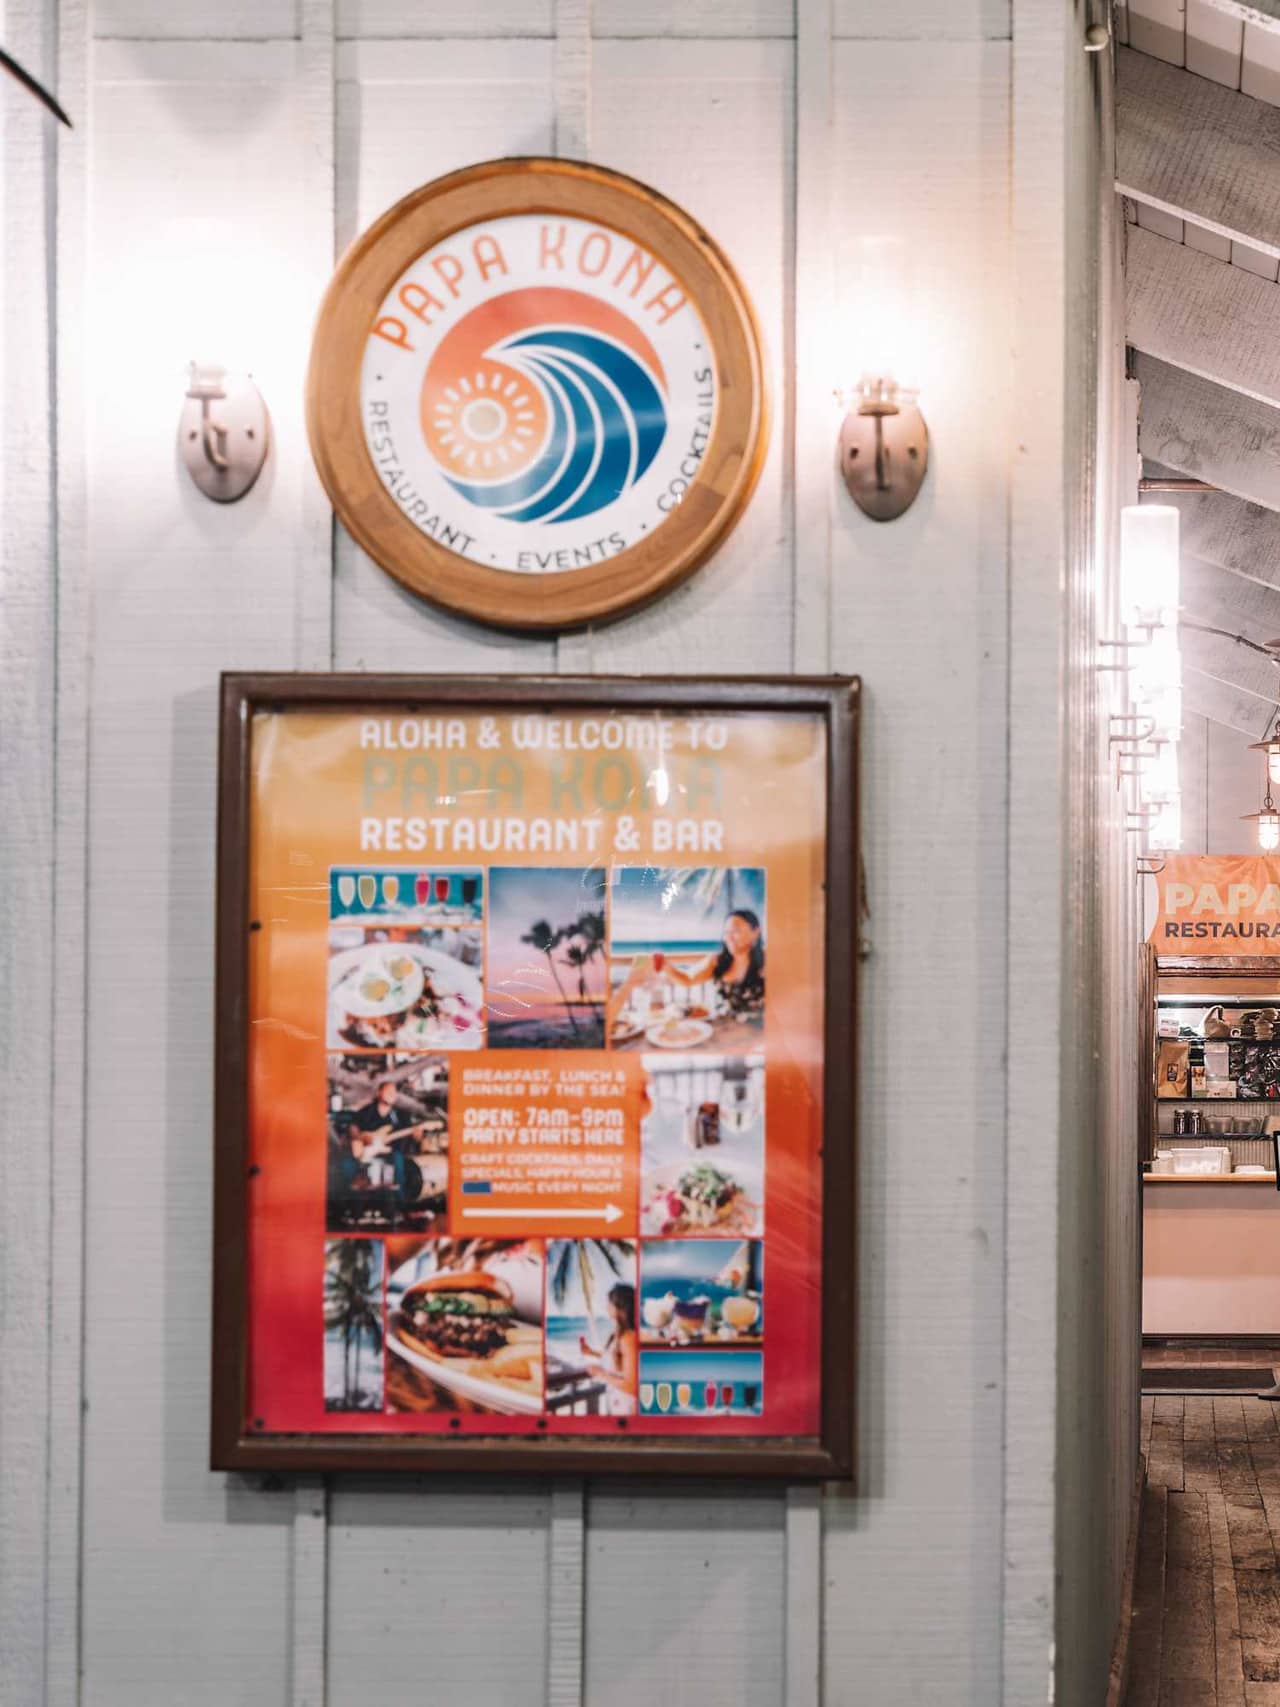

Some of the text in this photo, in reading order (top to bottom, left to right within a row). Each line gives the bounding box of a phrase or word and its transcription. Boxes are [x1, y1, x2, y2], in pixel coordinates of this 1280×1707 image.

[370, 224, 688, 352] PAPA KONA
[368, 366, 714, 570] RESTAURANT EVENTS COCKTAILS
[360, 716, 729, 750] ALOHA & WELCOME TO
[363, 754, 525, 812] PAPA
[360, 815, 725, 851] RESTAURANT & BAR
[559, 1070, 611, 1083] LUNCH
[462, 1083, 525, 1097] DINNER
[528, 1083, 551, 1097] BY
[555, 1084, 585, 1097] THE
[463, 1107, 521, 1126] OPEN:
[462, 1127, 625, 1146] PARTY STARTS HERE
[536, 1181, 578, 1193] EVERY
